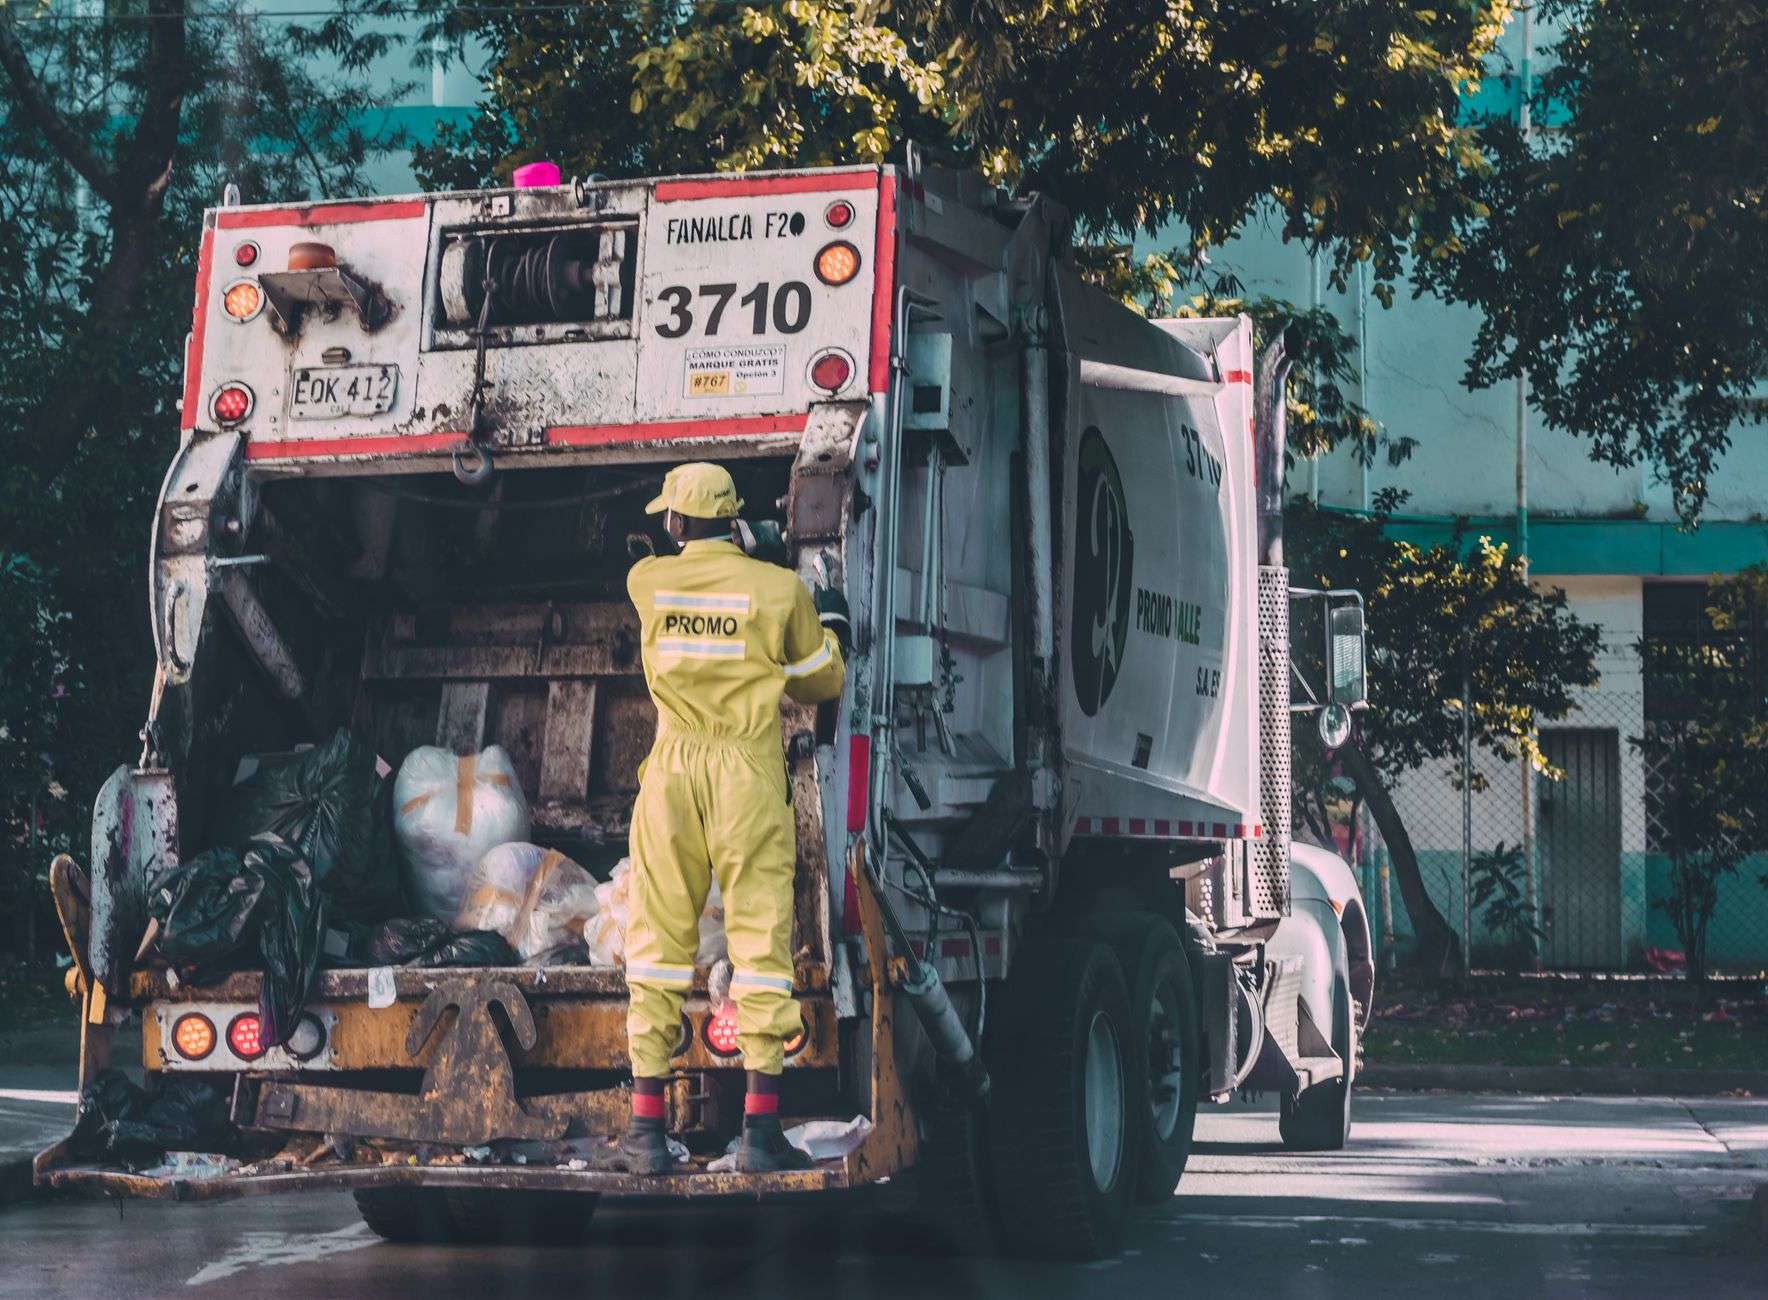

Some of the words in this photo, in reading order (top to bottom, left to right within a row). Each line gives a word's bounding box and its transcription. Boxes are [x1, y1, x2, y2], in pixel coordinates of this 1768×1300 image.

[667, 214, 752, 244] FANALCA
[655, 281, 812, 338] 3710
[689, 361, 735, 370] MARQUE
[739, 359, 778, 368] GRATIS
[347, 376, 392, 402] 412
[694, 375, 726, 388] #767
[665, 615, 738, 636] PROMO
[1136, 587, 1172, 638] PROMO
